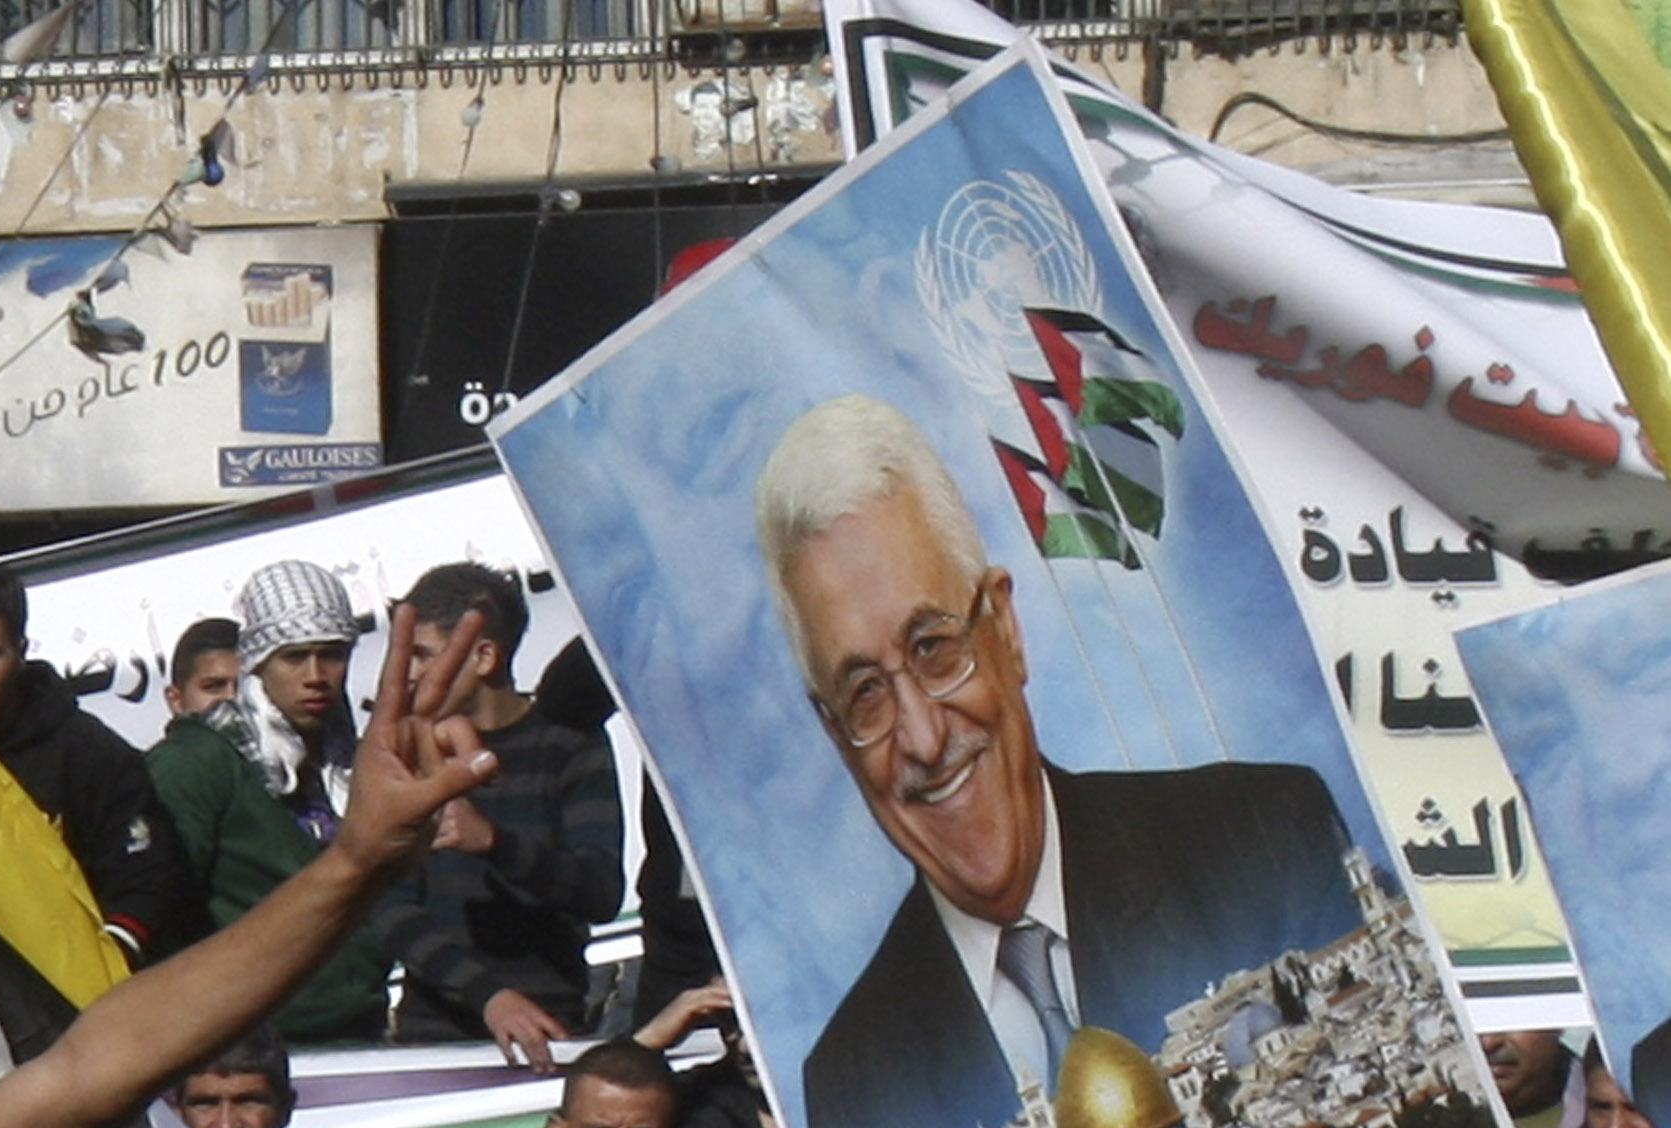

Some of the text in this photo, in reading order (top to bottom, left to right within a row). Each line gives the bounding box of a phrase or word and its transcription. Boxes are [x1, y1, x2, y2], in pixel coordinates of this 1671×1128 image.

[155, 332, 230, 386] 100
[1193, 295, 1435, 409] فوريك
[4, 389, 65, 437] من
[78, 361, 140, 419] عام
[1449, 362, 1620, 480] بيت
[264, 446, 378, 469] GAULOISES
[1299, 505, 1497, 607] قيادة
